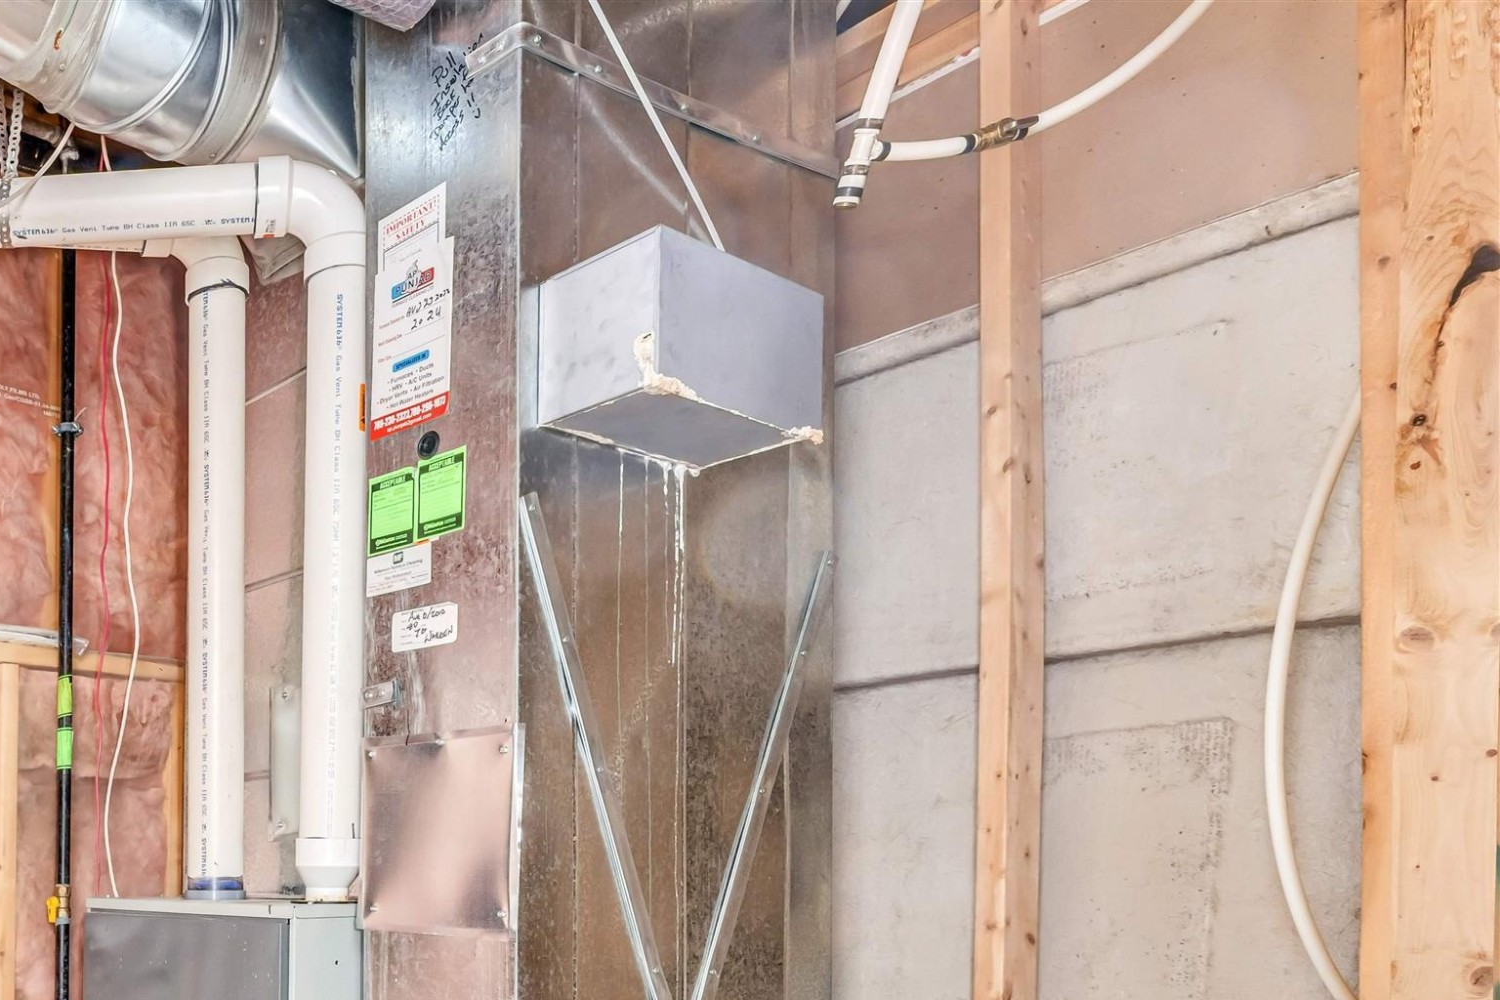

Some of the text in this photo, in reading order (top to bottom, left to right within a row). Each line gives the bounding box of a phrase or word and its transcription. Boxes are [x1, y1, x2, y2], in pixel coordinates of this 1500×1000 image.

[62, 226, 78, 234] Gas
[136, 221, 160, 230] Class
[395, 272, 432, 295] PUNJAB
